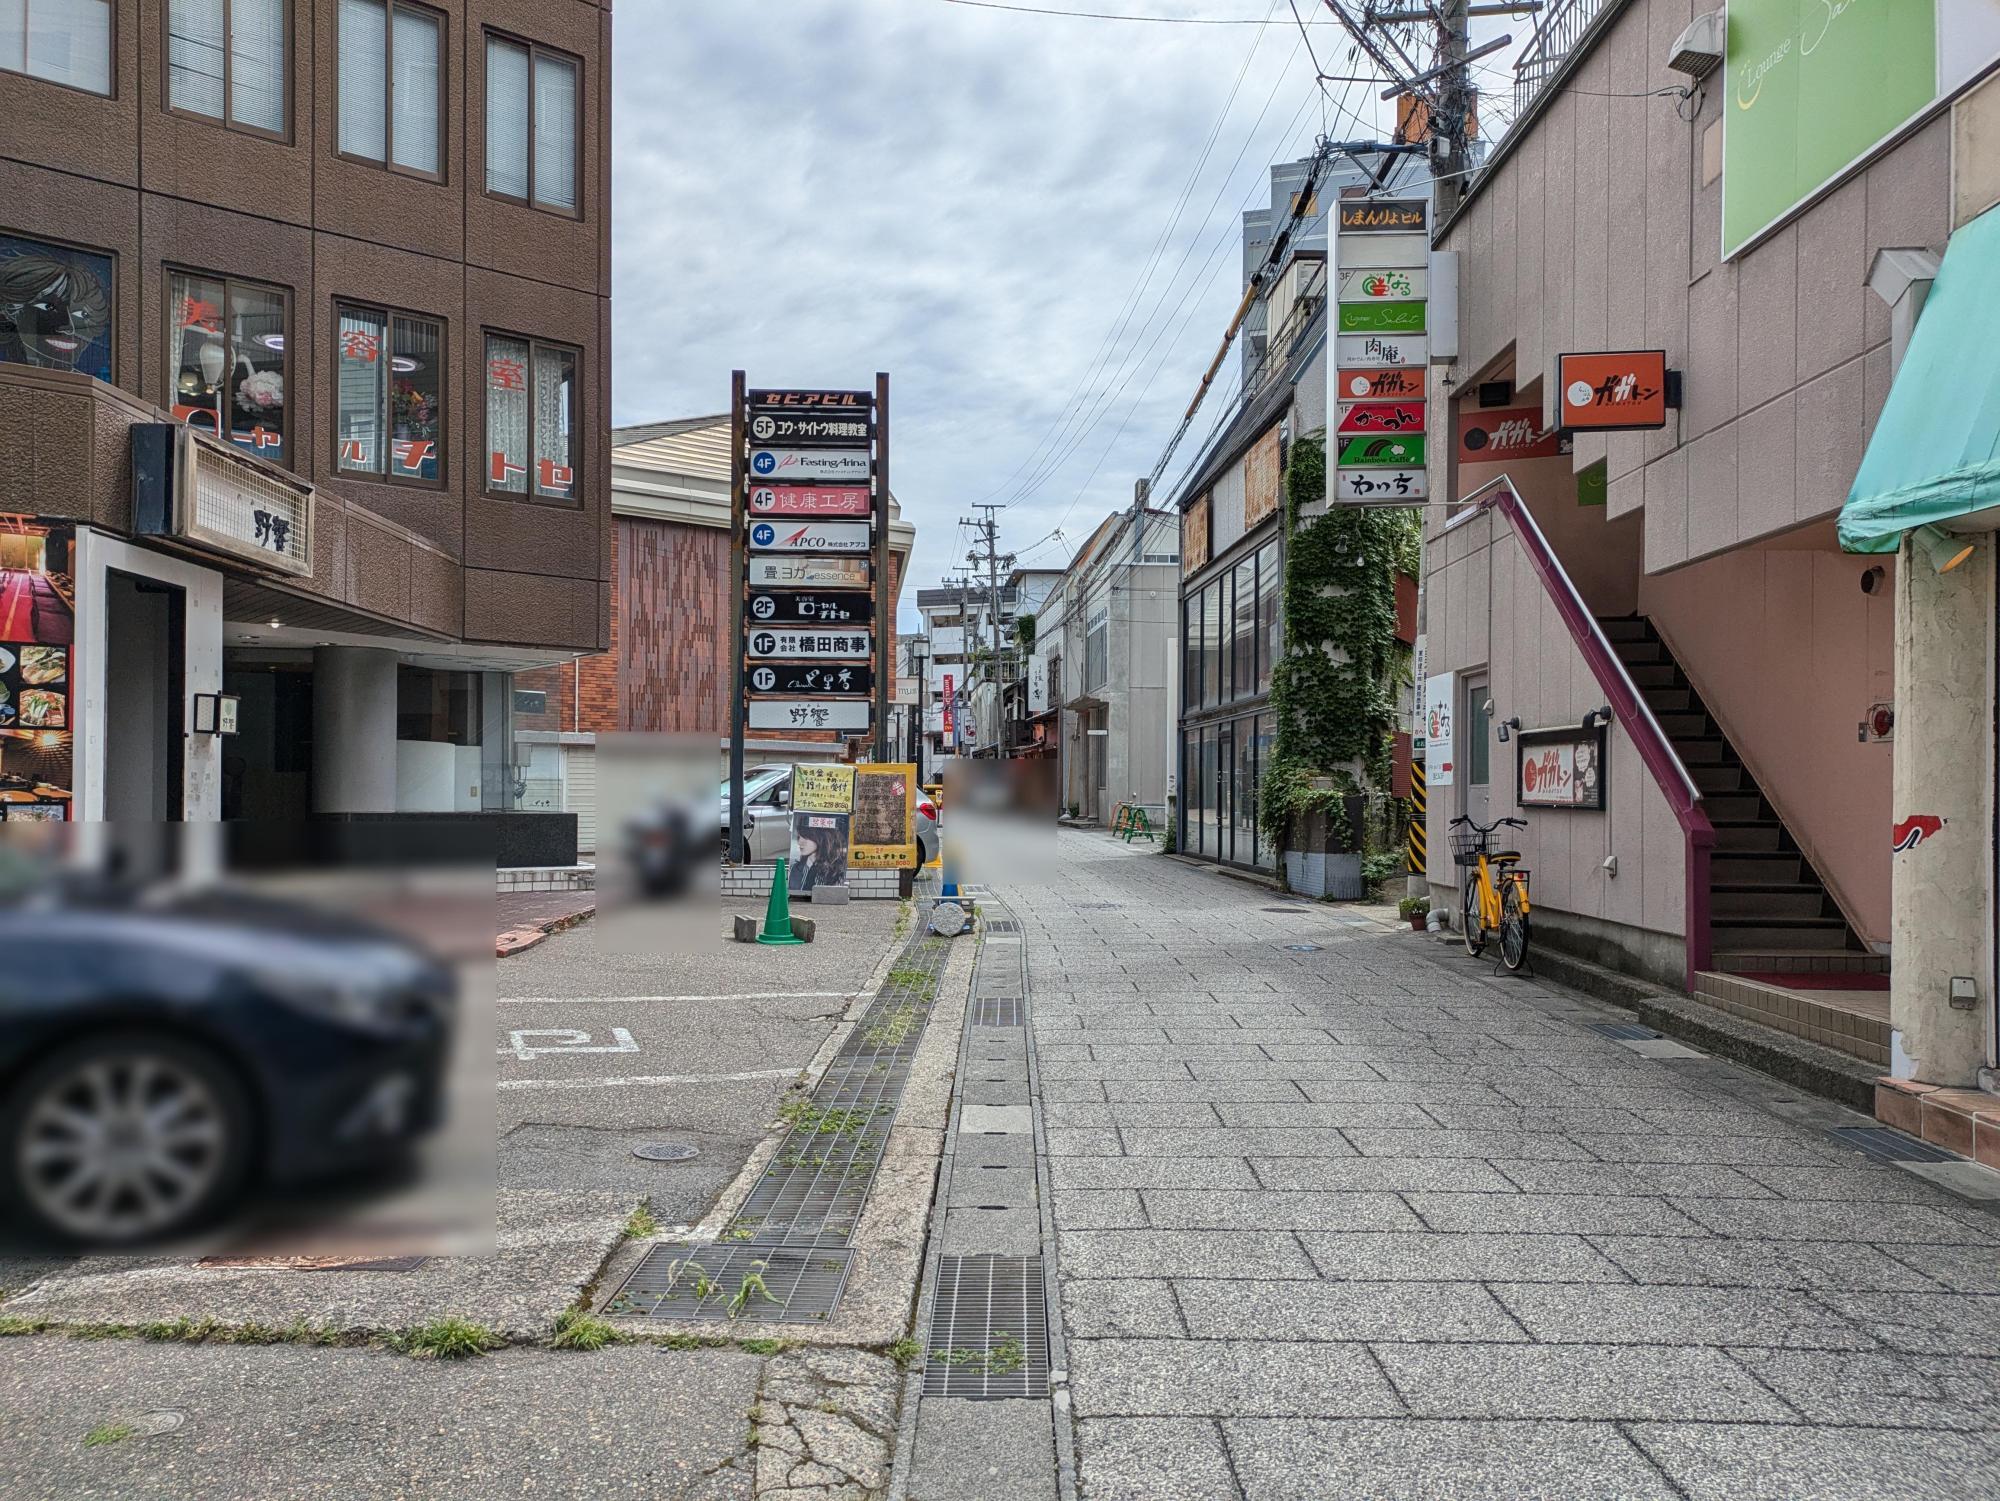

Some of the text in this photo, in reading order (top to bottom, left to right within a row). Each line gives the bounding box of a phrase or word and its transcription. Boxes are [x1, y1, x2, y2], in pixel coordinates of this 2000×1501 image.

[1746, 37, 1792, 88] Lounge
[1339, 272, 1350, 281] 3F
[1370, 371, 1420, 396] ガガトン
[1593, 372, 1659, 406] ガガトン
[1339, 405, 1350, 414] 1F
[754, 421, 773, 434] 5F
[756, 458, 772, 468] 4F
[754, 492, 773, 506] 4F
[780, 492, 859, 509] 健康工房
[756, 530, 772, 540] 4F
[788, 537, 826, 548] APCO
[814, 571, 855, 581] essence
[755, 600, 773, 614] 2F
[756, 637, 773, 647] 1F
[799, 636, 866, 653] 橋田商事
[757, 672, 773, 685] 1F
